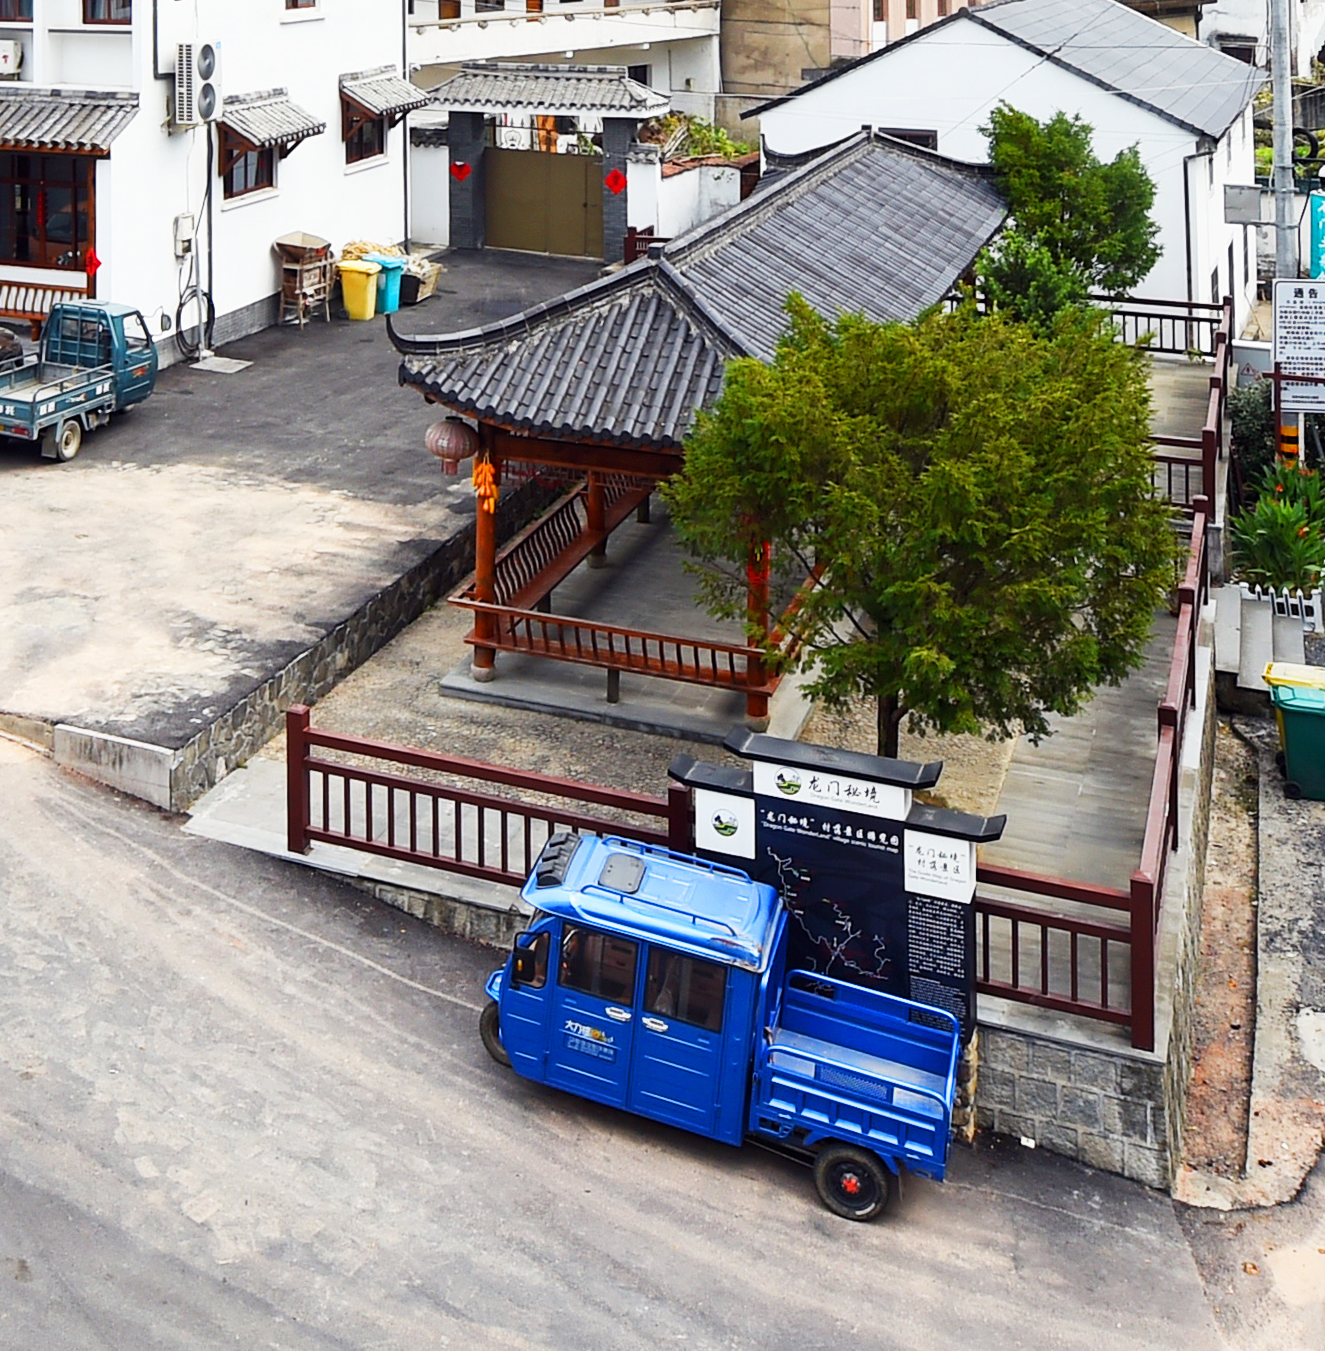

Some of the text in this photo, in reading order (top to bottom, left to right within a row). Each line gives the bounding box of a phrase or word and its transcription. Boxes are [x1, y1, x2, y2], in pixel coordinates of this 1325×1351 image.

[1293, 287, 1318, 299] 通告
[808, 776, 880, 803] 龙门秘境
[832, 836, 850, 845] village
[851, 839, 867, 847] scenic
[886, 846, 899, 854] map
